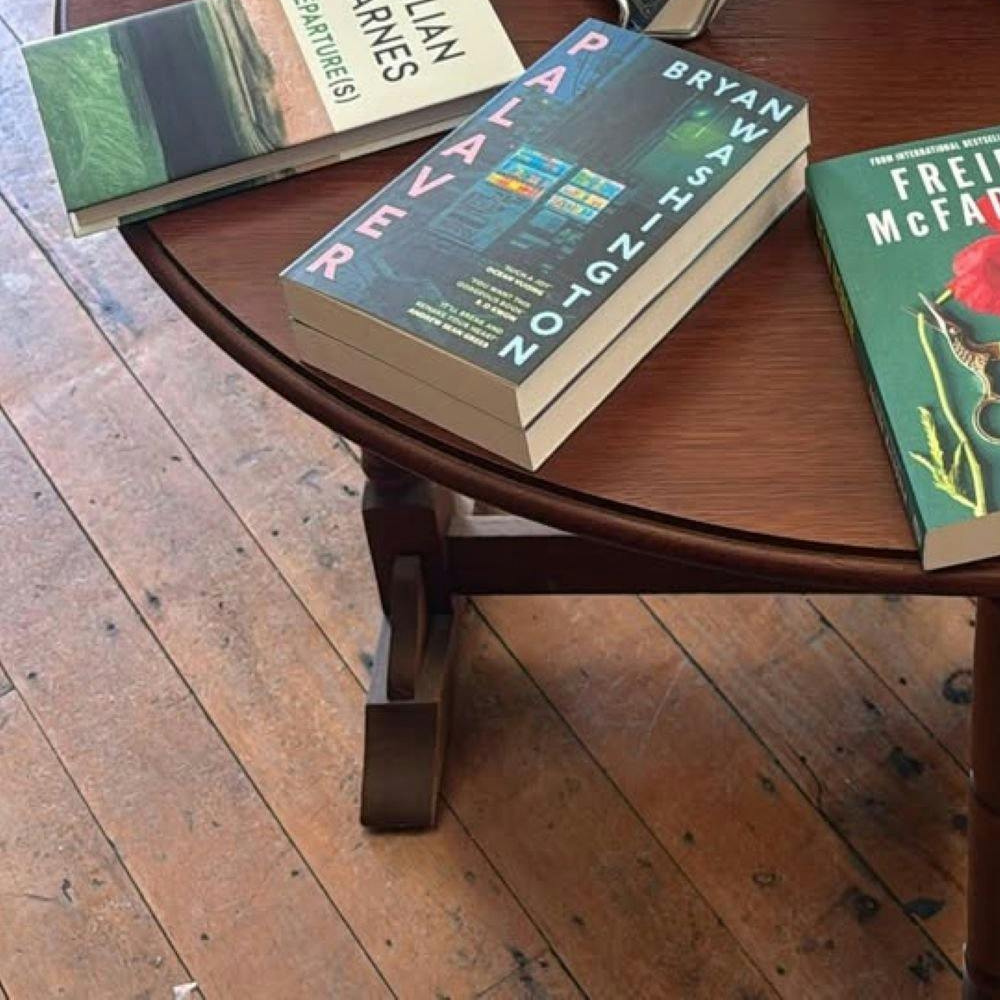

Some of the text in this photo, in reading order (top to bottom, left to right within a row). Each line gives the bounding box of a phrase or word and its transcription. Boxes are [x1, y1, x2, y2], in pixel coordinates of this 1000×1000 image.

[307, 31, 611, 281] PALAVER
[662, 58, 795, 122] BRYAN
[869, 153, 894, 168] FROM
[895, 140, 961, 163] INTERNATIONAL
[498, 117, 771, 367] WASHINGTON
